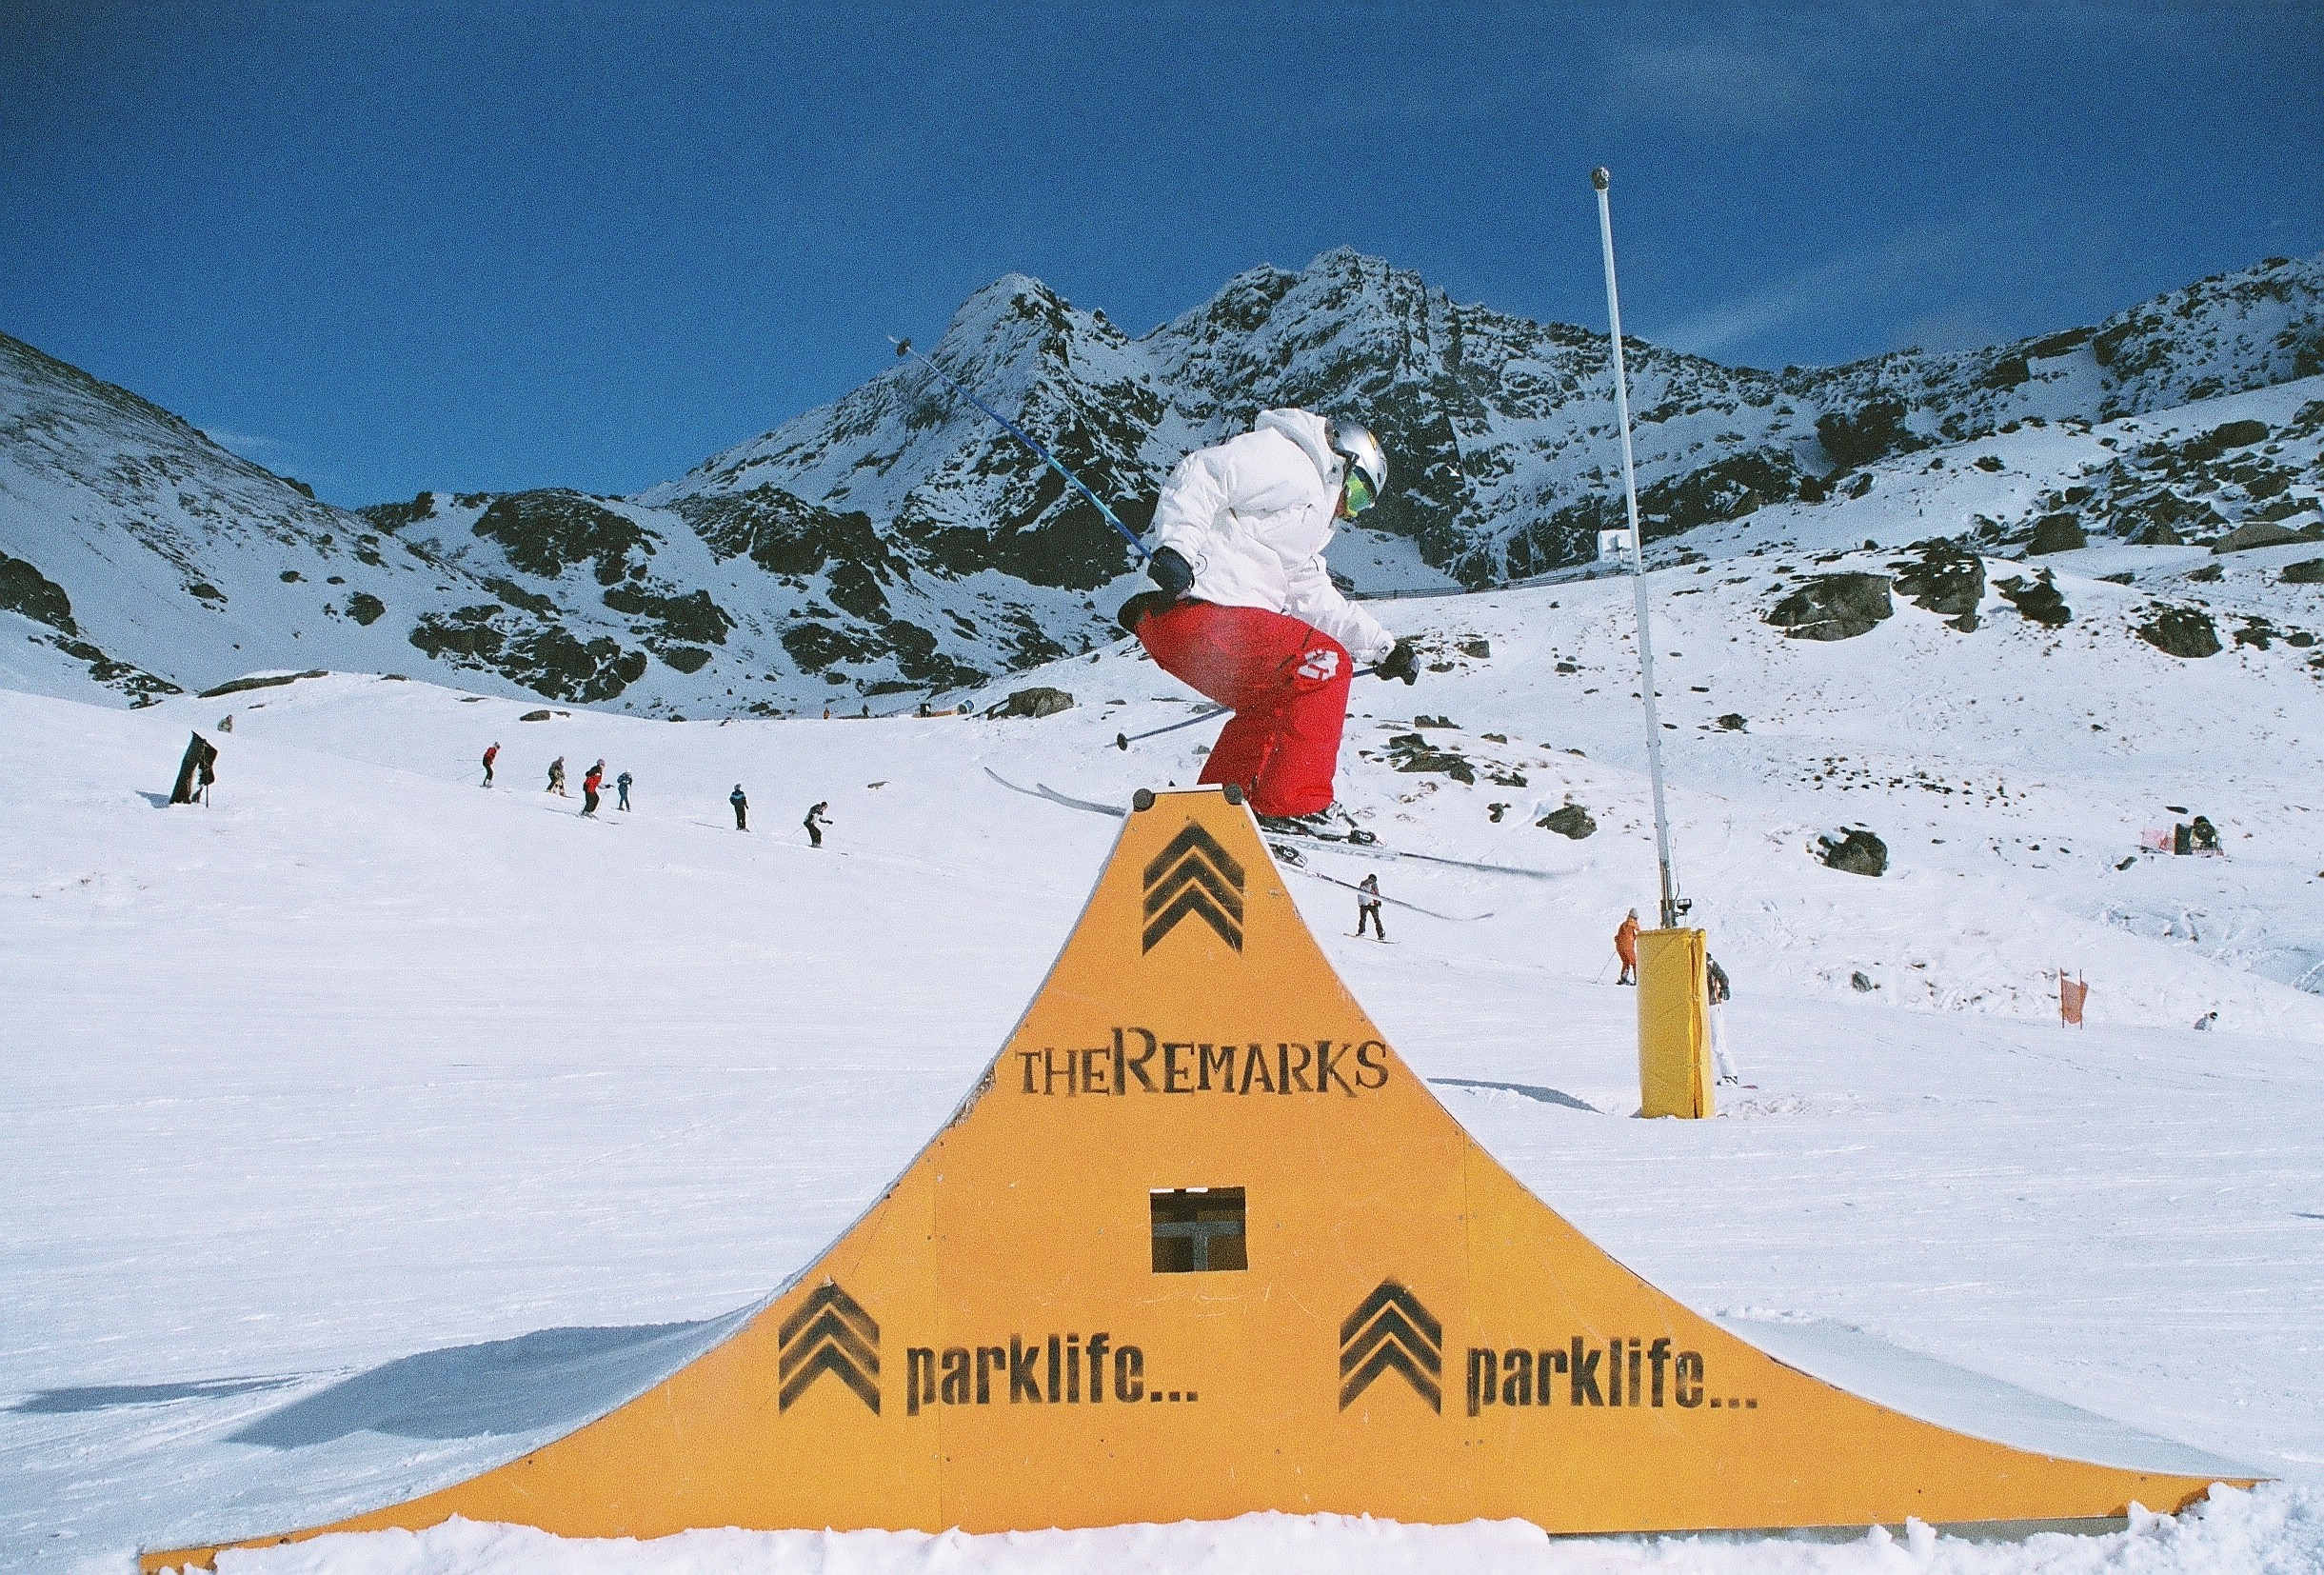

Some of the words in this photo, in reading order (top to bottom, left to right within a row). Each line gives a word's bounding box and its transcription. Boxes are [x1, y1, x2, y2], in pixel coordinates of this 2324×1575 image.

[1359, 832, 1371, 841] 10
[906, 1332, 1199, 1416] parklife...
[1467, 1336, 1758, 1417] parklife...
